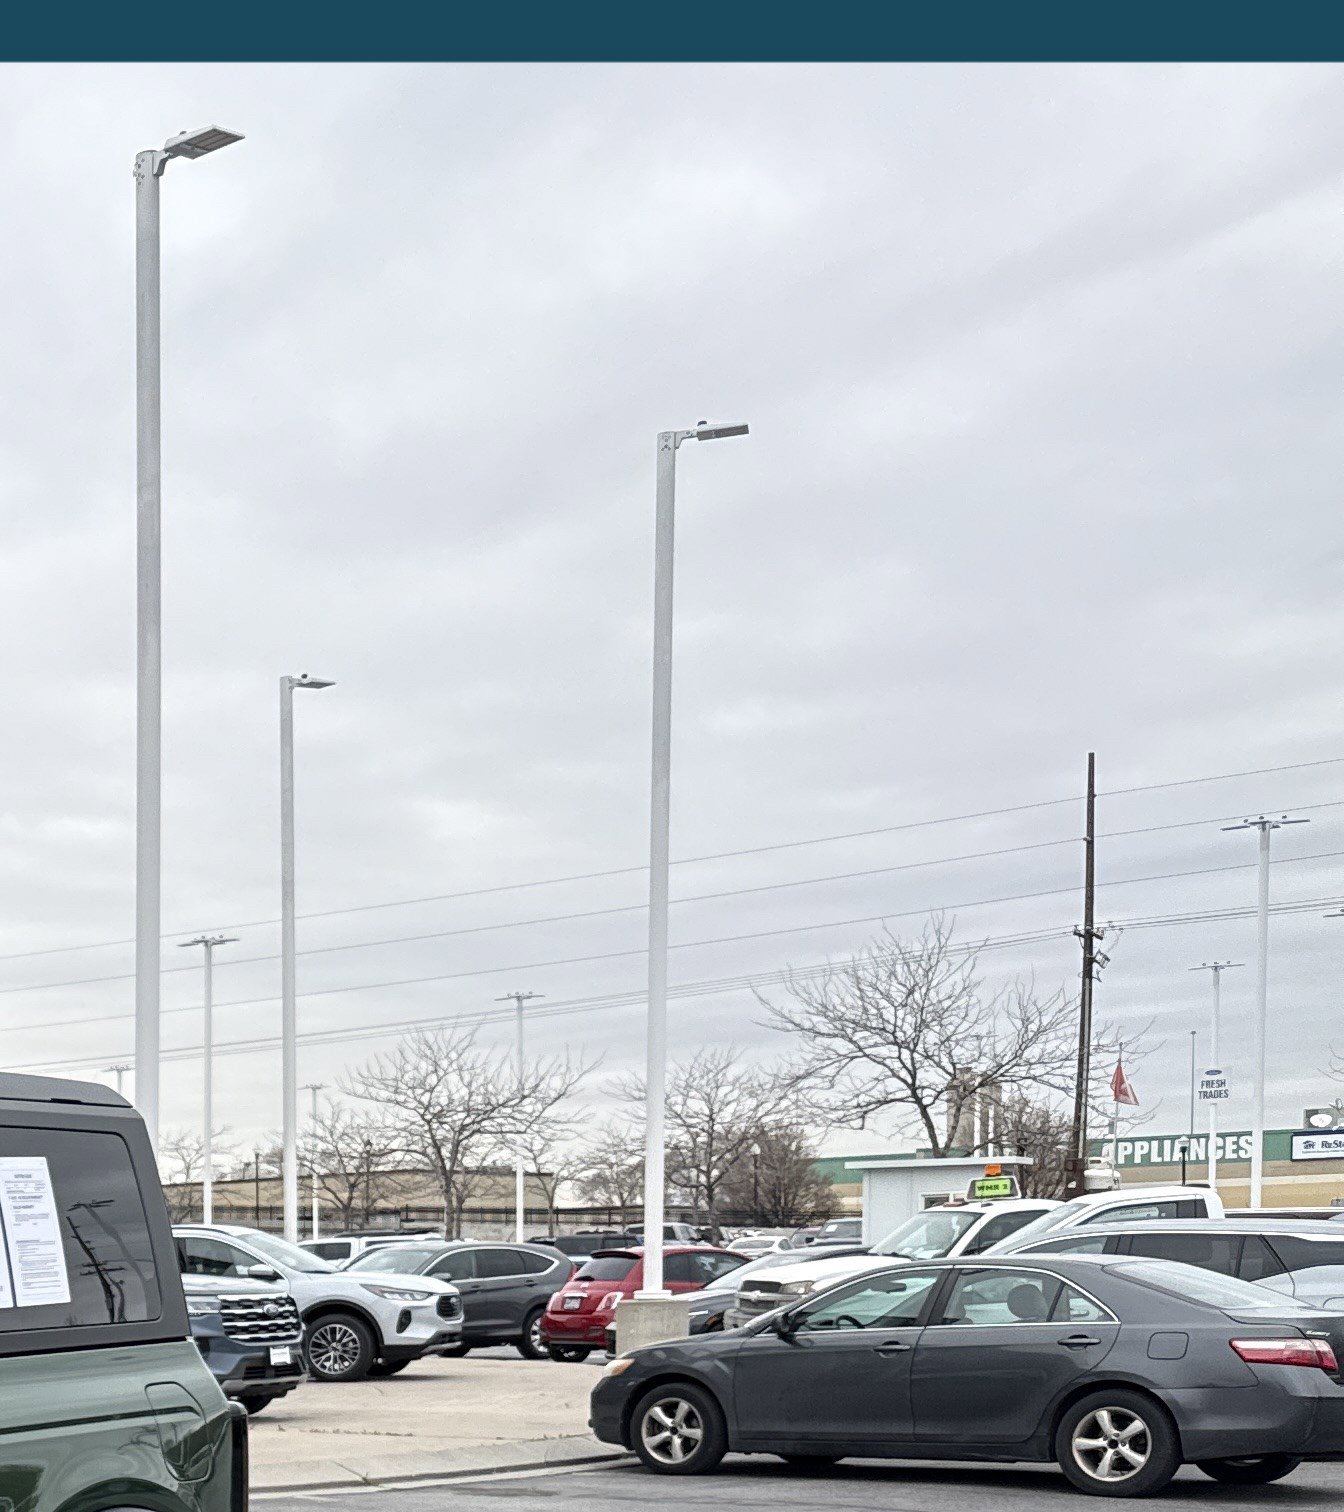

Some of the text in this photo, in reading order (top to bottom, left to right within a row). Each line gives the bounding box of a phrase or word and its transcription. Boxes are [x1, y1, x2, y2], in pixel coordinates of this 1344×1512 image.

[1200, 1078, 1227, 1090] FRESH
[1197, 1089, 1230, 1100] TRADES
[1101, 1134, 1254, 1166] APPLIANCES
